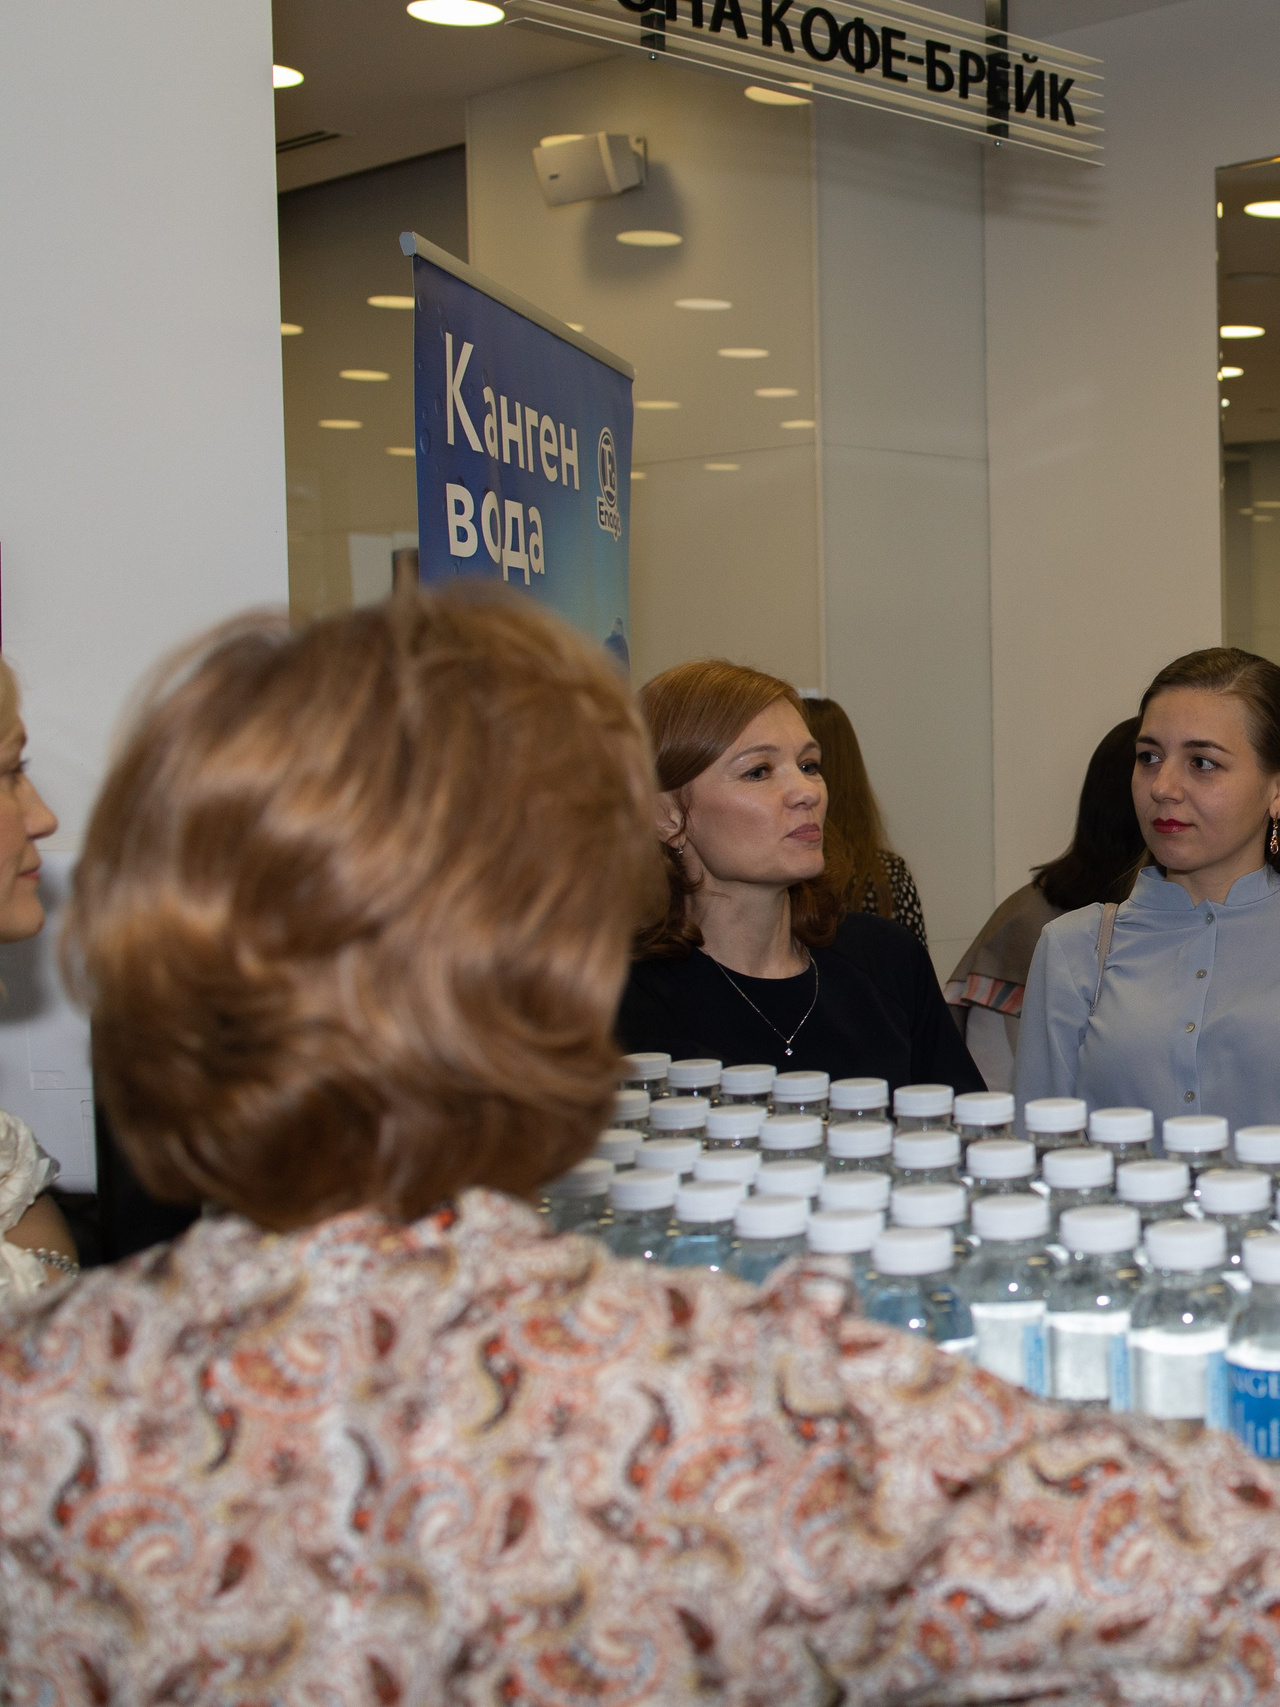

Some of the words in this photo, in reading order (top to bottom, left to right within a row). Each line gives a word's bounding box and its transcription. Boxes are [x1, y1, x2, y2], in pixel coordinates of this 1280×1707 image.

[613, 0, 749, 40] НА
[761, 0, 1076, 127] КОФЕ-БРЕЙК
[445, 331, 580, 491] Канген
[445, 482, 546, 586] вода
